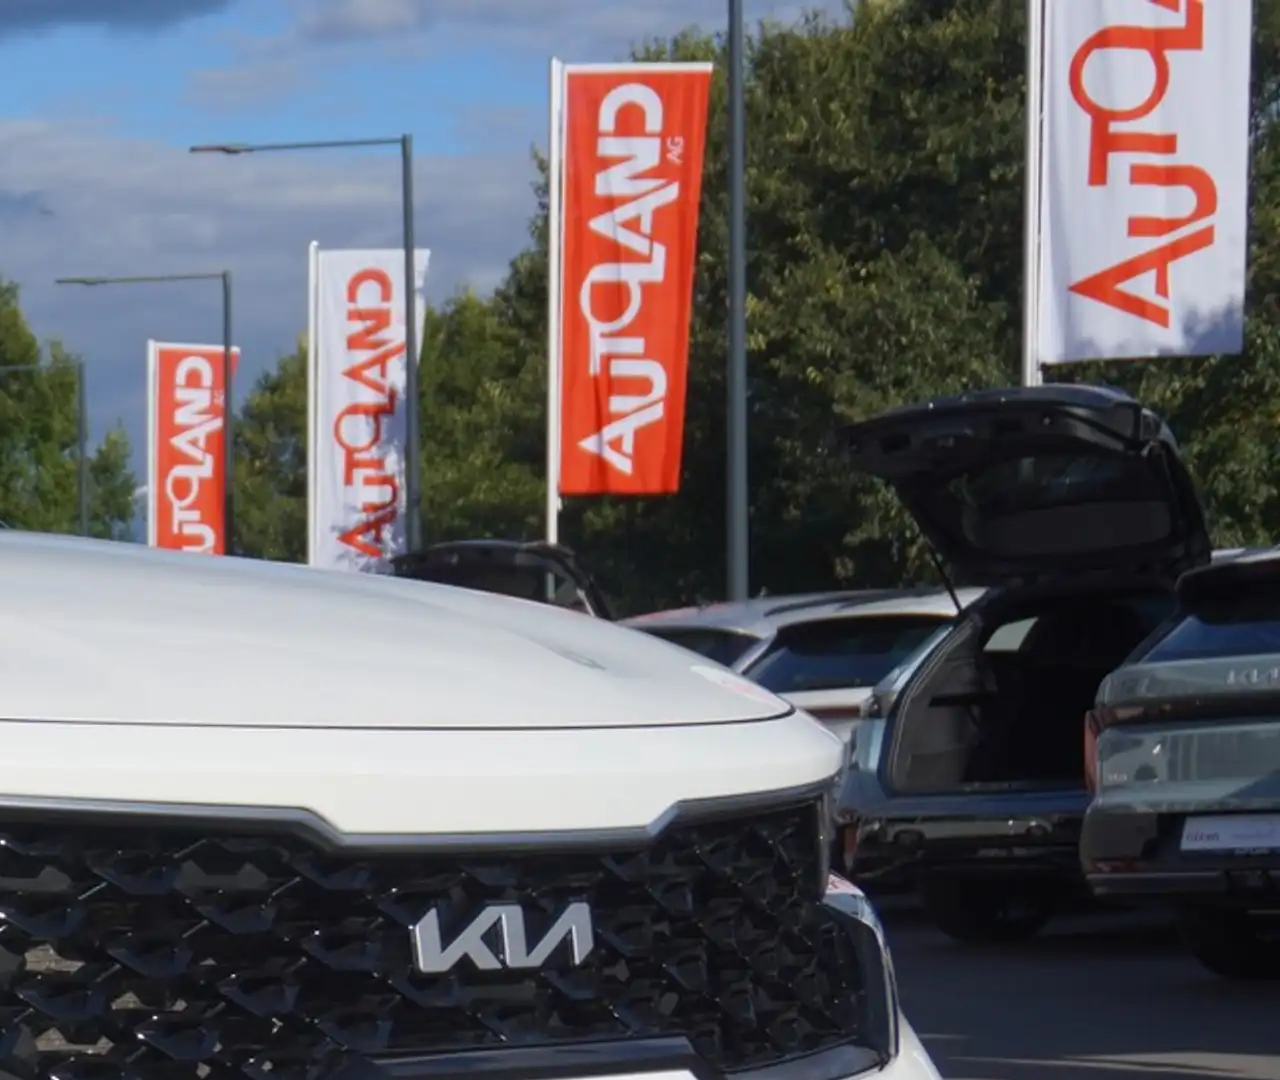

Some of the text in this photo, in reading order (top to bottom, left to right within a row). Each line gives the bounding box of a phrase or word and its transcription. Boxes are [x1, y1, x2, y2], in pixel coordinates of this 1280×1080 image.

[577, 82, 679, 476] AUTOLAND
[1068, 0, 1218, 329] AUTOL
[165, 355, 225, 554] UTOLAND
[333, 267, 406, 559] AUTOLAND
[414, 902, 595, 973] KIA
